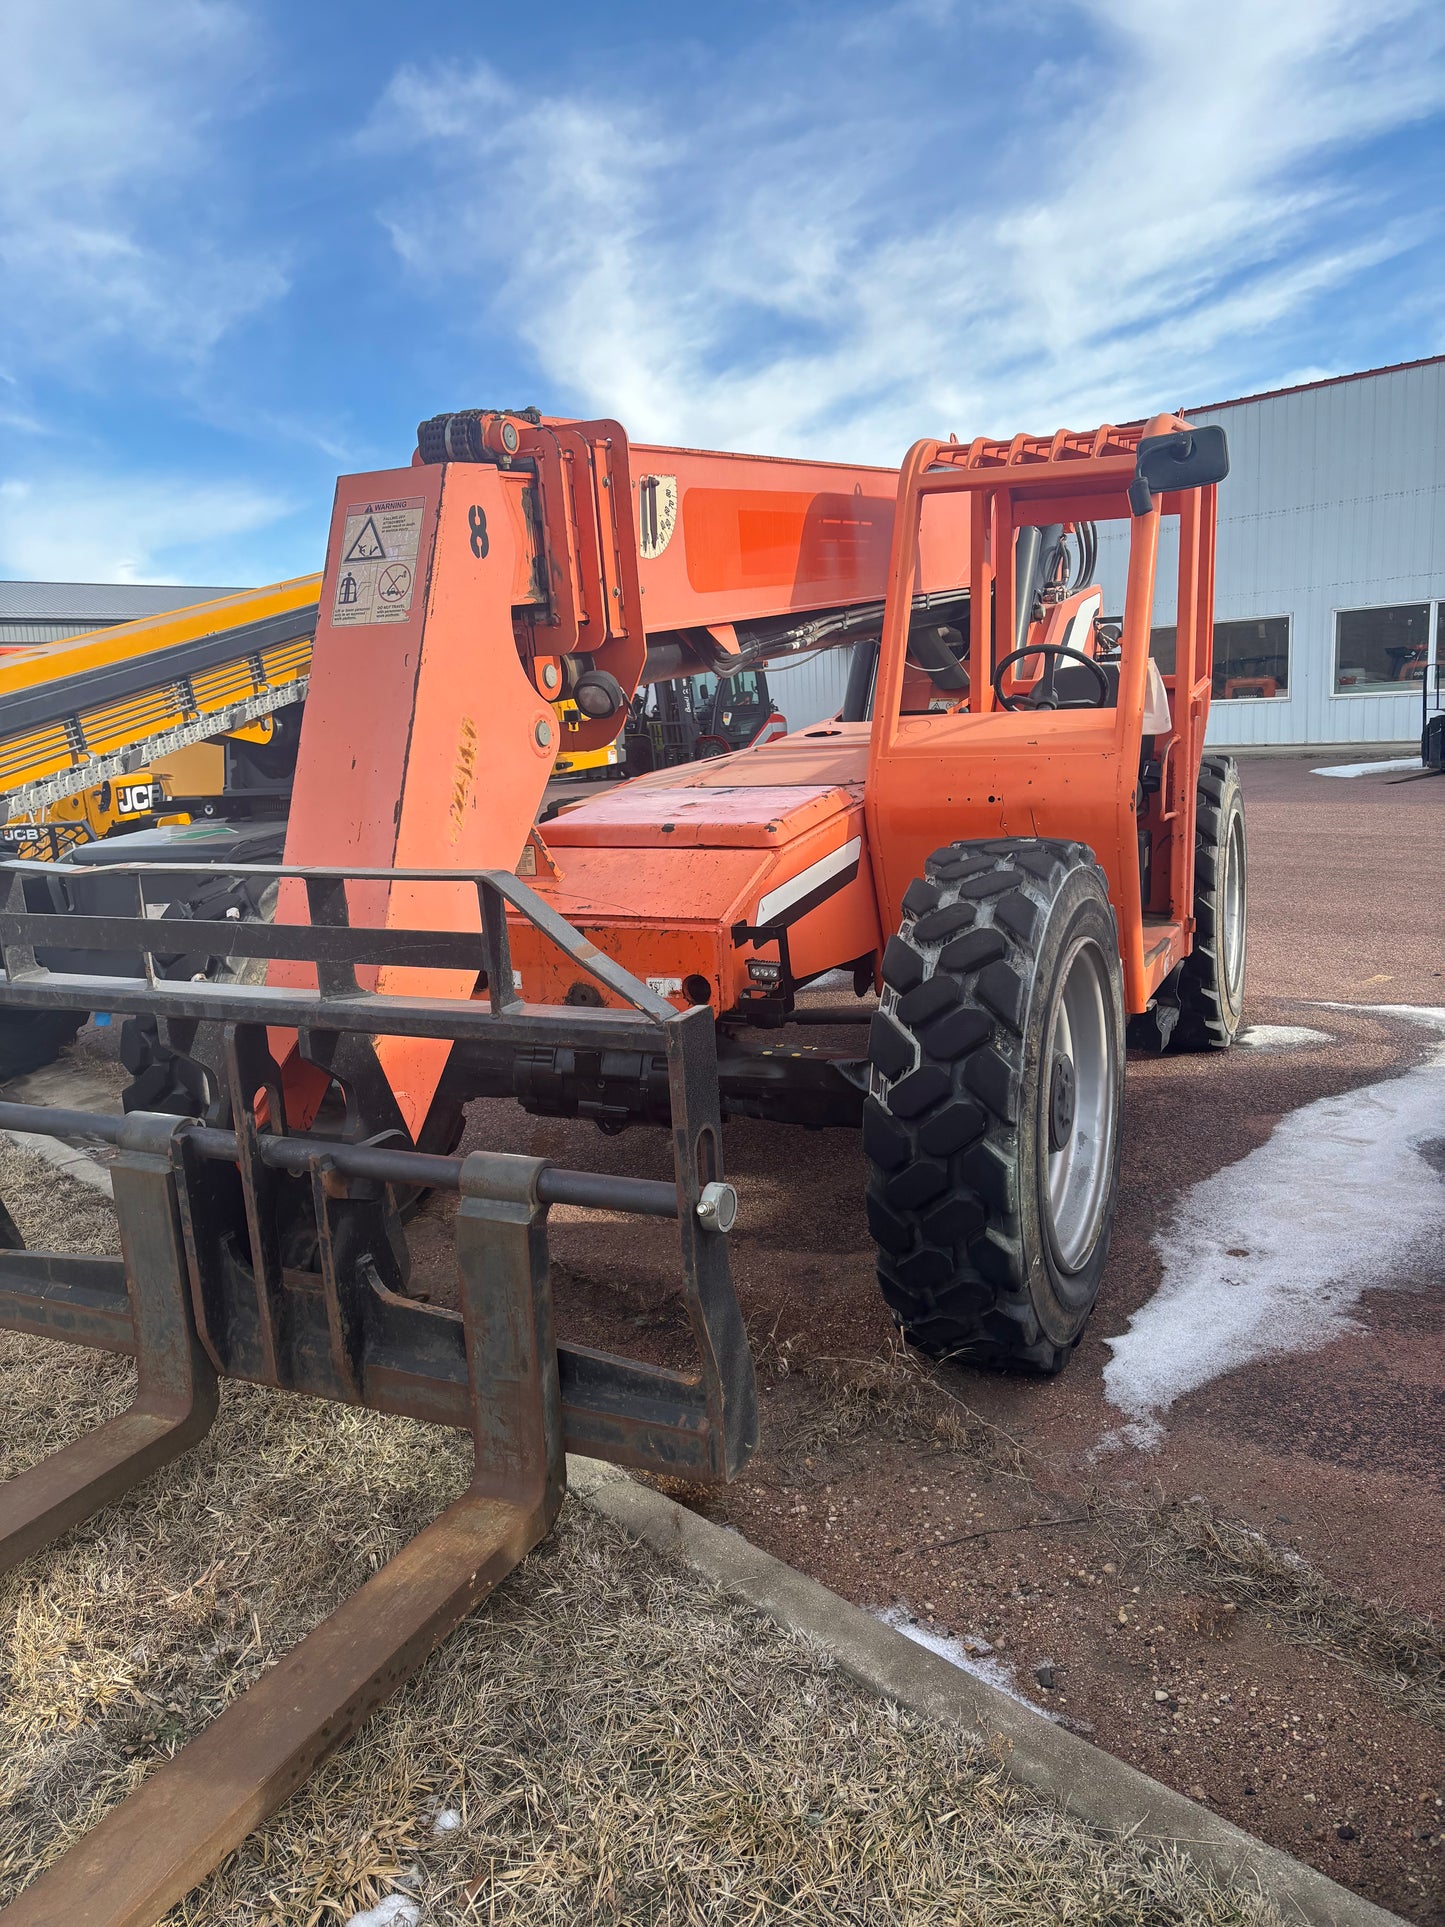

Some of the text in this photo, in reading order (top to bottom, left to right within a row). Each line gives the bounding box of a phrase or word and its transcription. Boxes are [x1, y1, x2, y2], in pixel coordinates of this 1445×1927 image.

[375, 501, 407, 511] WARNING
[468, 504, 490, 559] 8
[118, 785, 153, 812] JC
[4, 828, 39, 841] JCB
